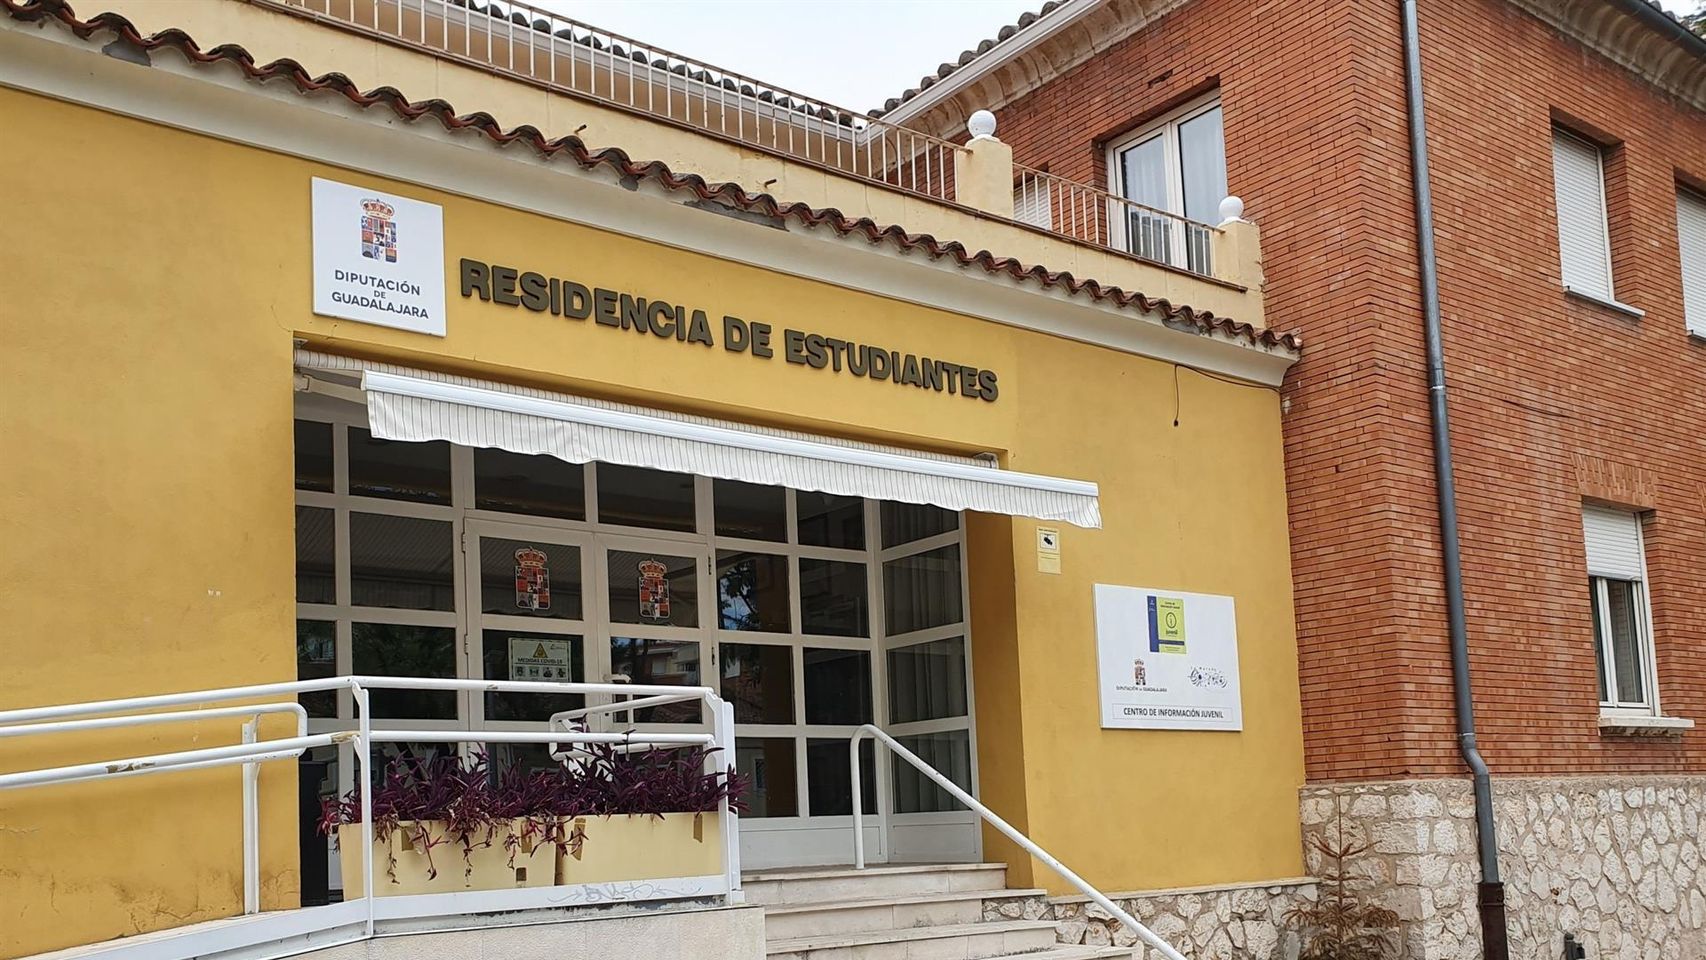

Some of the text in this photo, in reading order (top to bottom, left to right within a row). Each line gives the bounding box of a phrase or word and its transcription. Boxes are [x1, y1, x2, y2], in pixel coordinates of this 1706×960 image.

[335, 269, 420, 296] DIPUTACIÓN
[374, 290, 386, 299] DE
[332, 291, 429, 319] GUADALAJARA
[459, 257, 998, 402] RESIDENCIA DE ESTUDIANTES
[1123, 707, 1224, 718] CENTRO DE INFORMACIÓN JUVENIL
